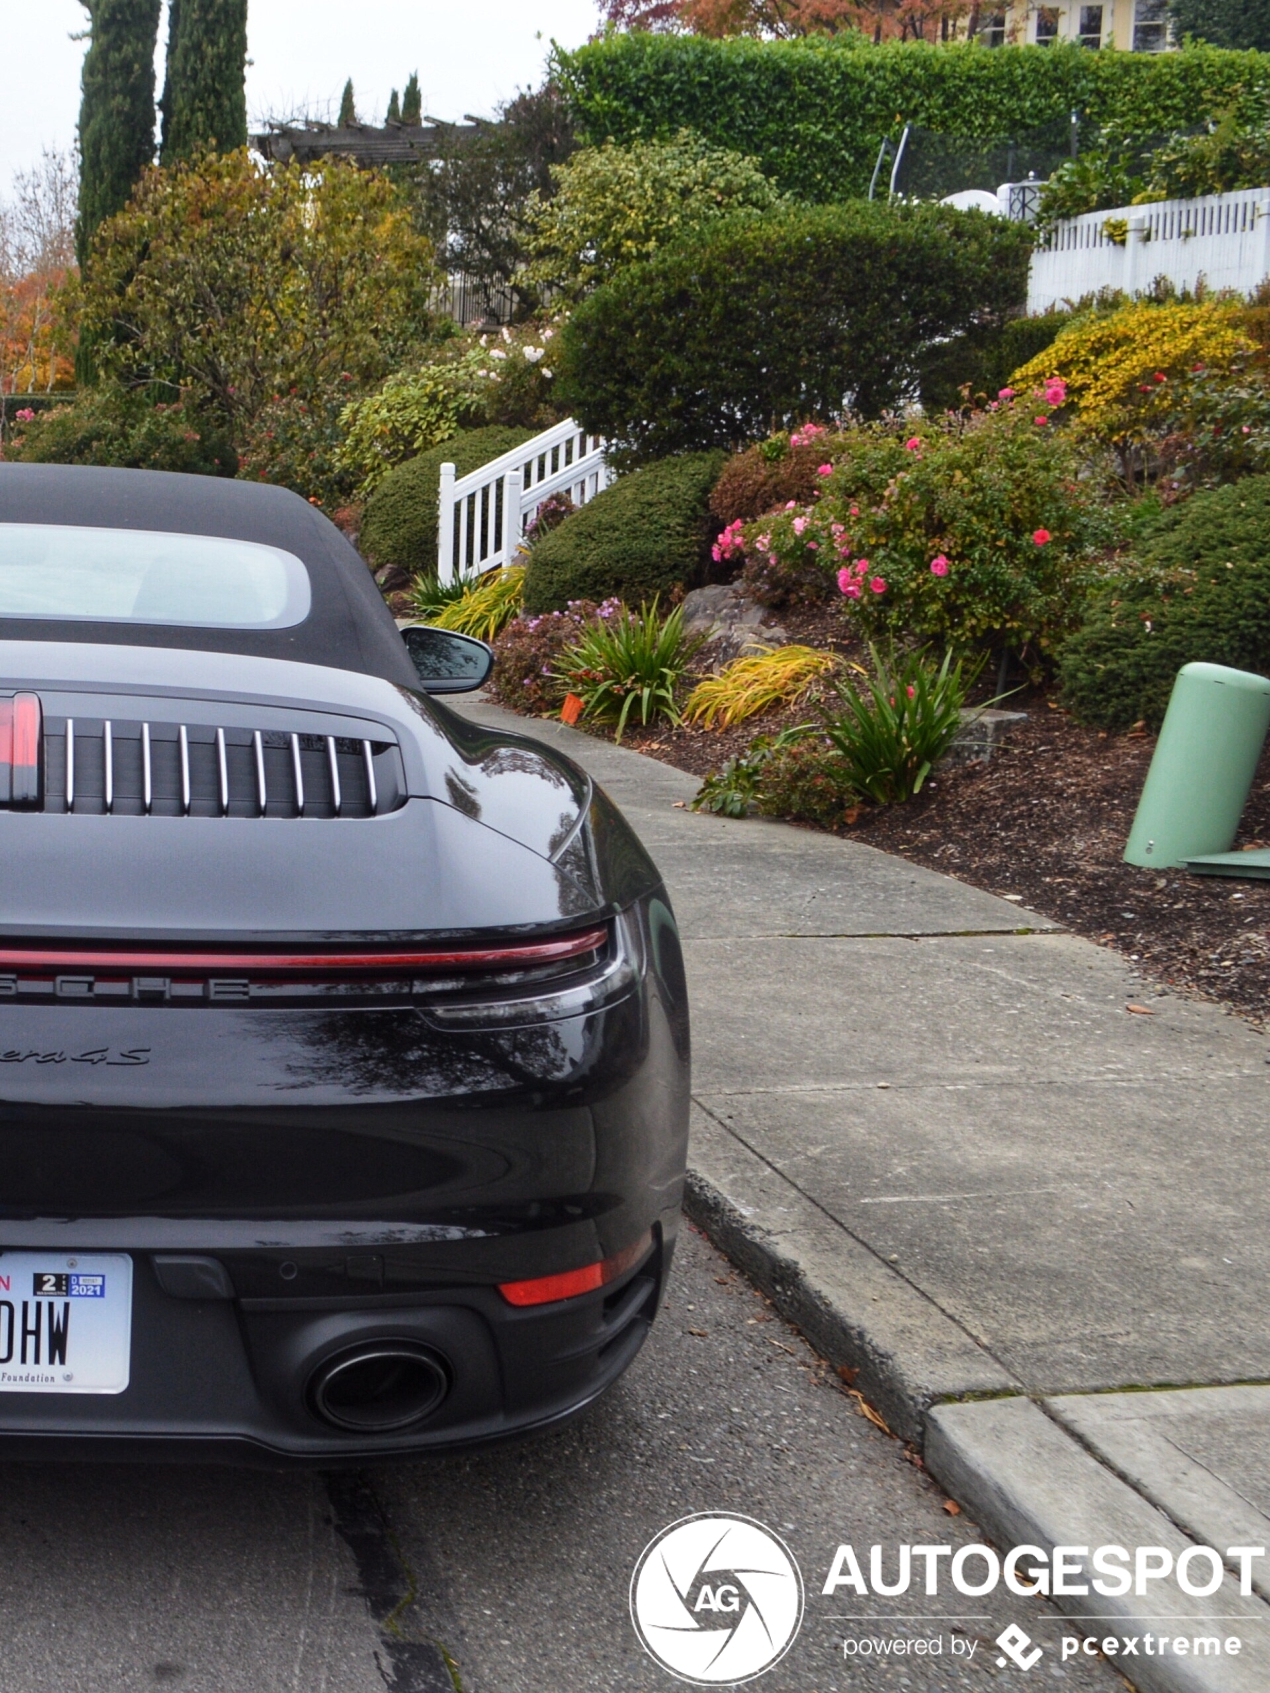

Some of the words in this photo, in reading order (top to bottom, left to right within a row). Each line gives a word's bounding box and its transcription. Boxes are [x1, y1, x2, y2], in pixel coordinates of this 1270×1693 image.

[71, 1047, 151, 1066] 4S
[42, 1274, 56, 1291] 2
[71, 1285, 101, 1296] 2021
[1, 1372, 55, 1383] Foundation
